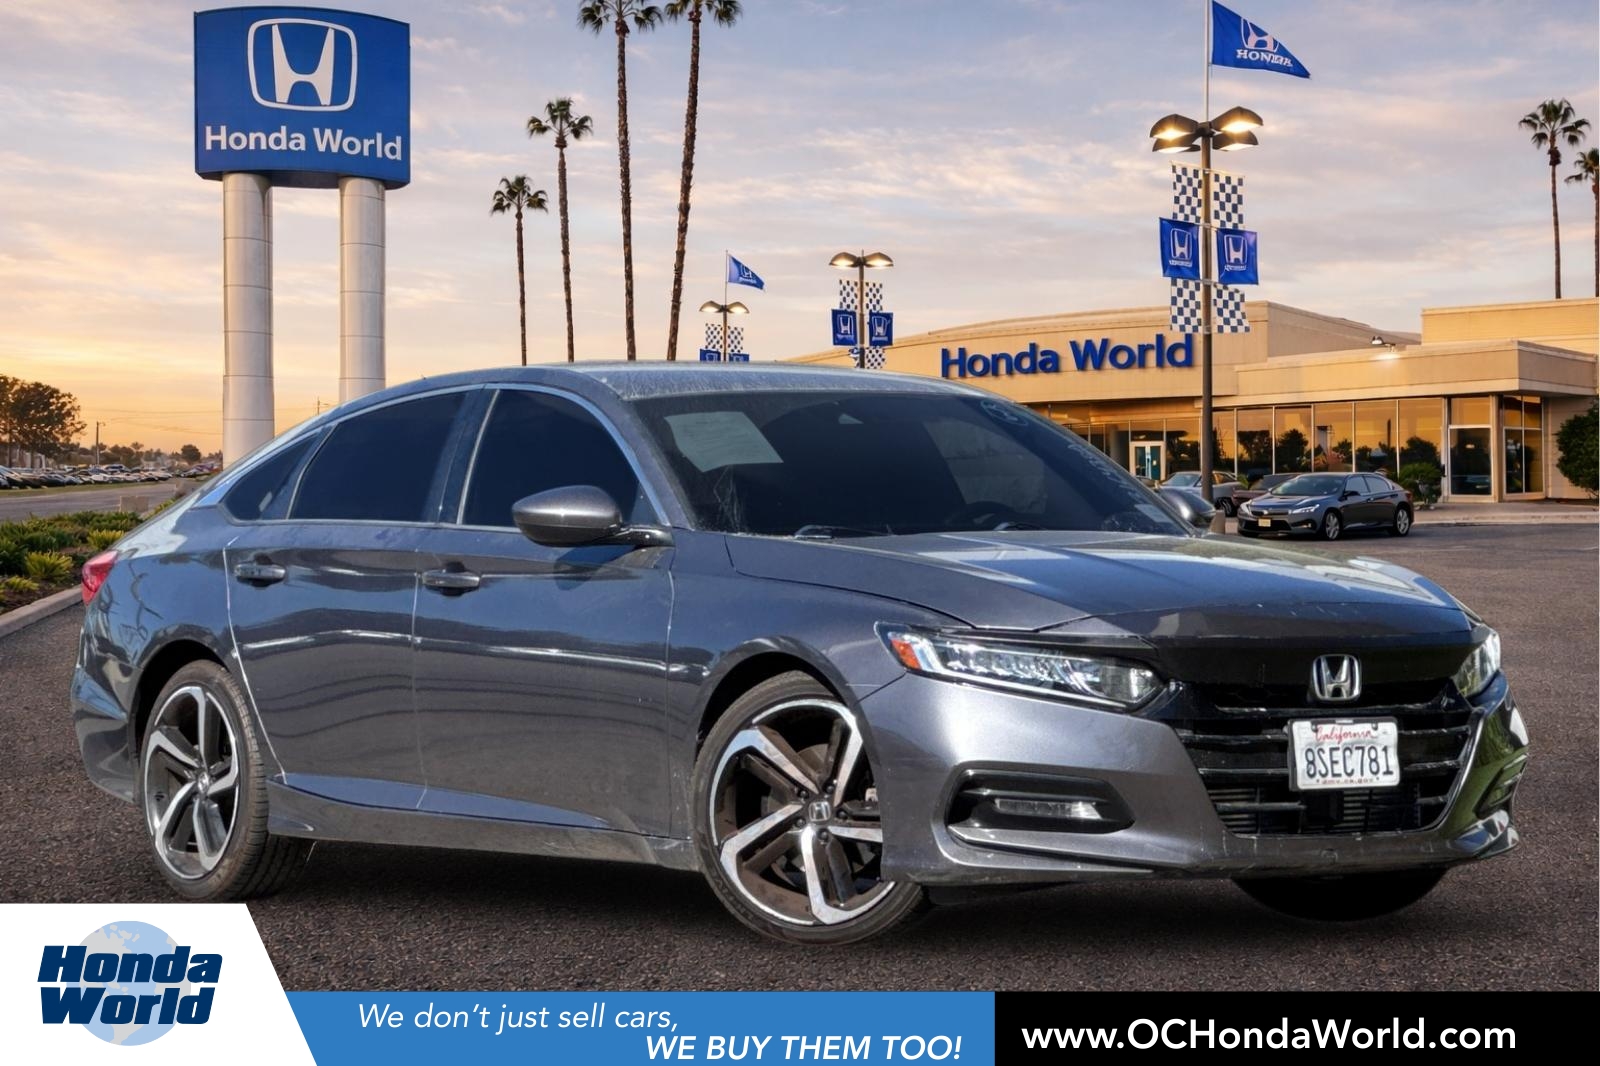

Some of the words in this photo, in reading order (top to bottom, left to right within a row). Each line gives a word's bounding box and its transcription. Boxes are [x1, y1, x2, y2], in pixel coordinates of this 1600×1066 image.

[205, 125, 306, 151] Honda
[313, 128, 402, 161] World
[941, 343, 1061, 378] Honda
[1070, 333, 1194, 371] World
[1316, 726, 1378, 744] California
[1305, 745, 1394, 779] 8SEC781
